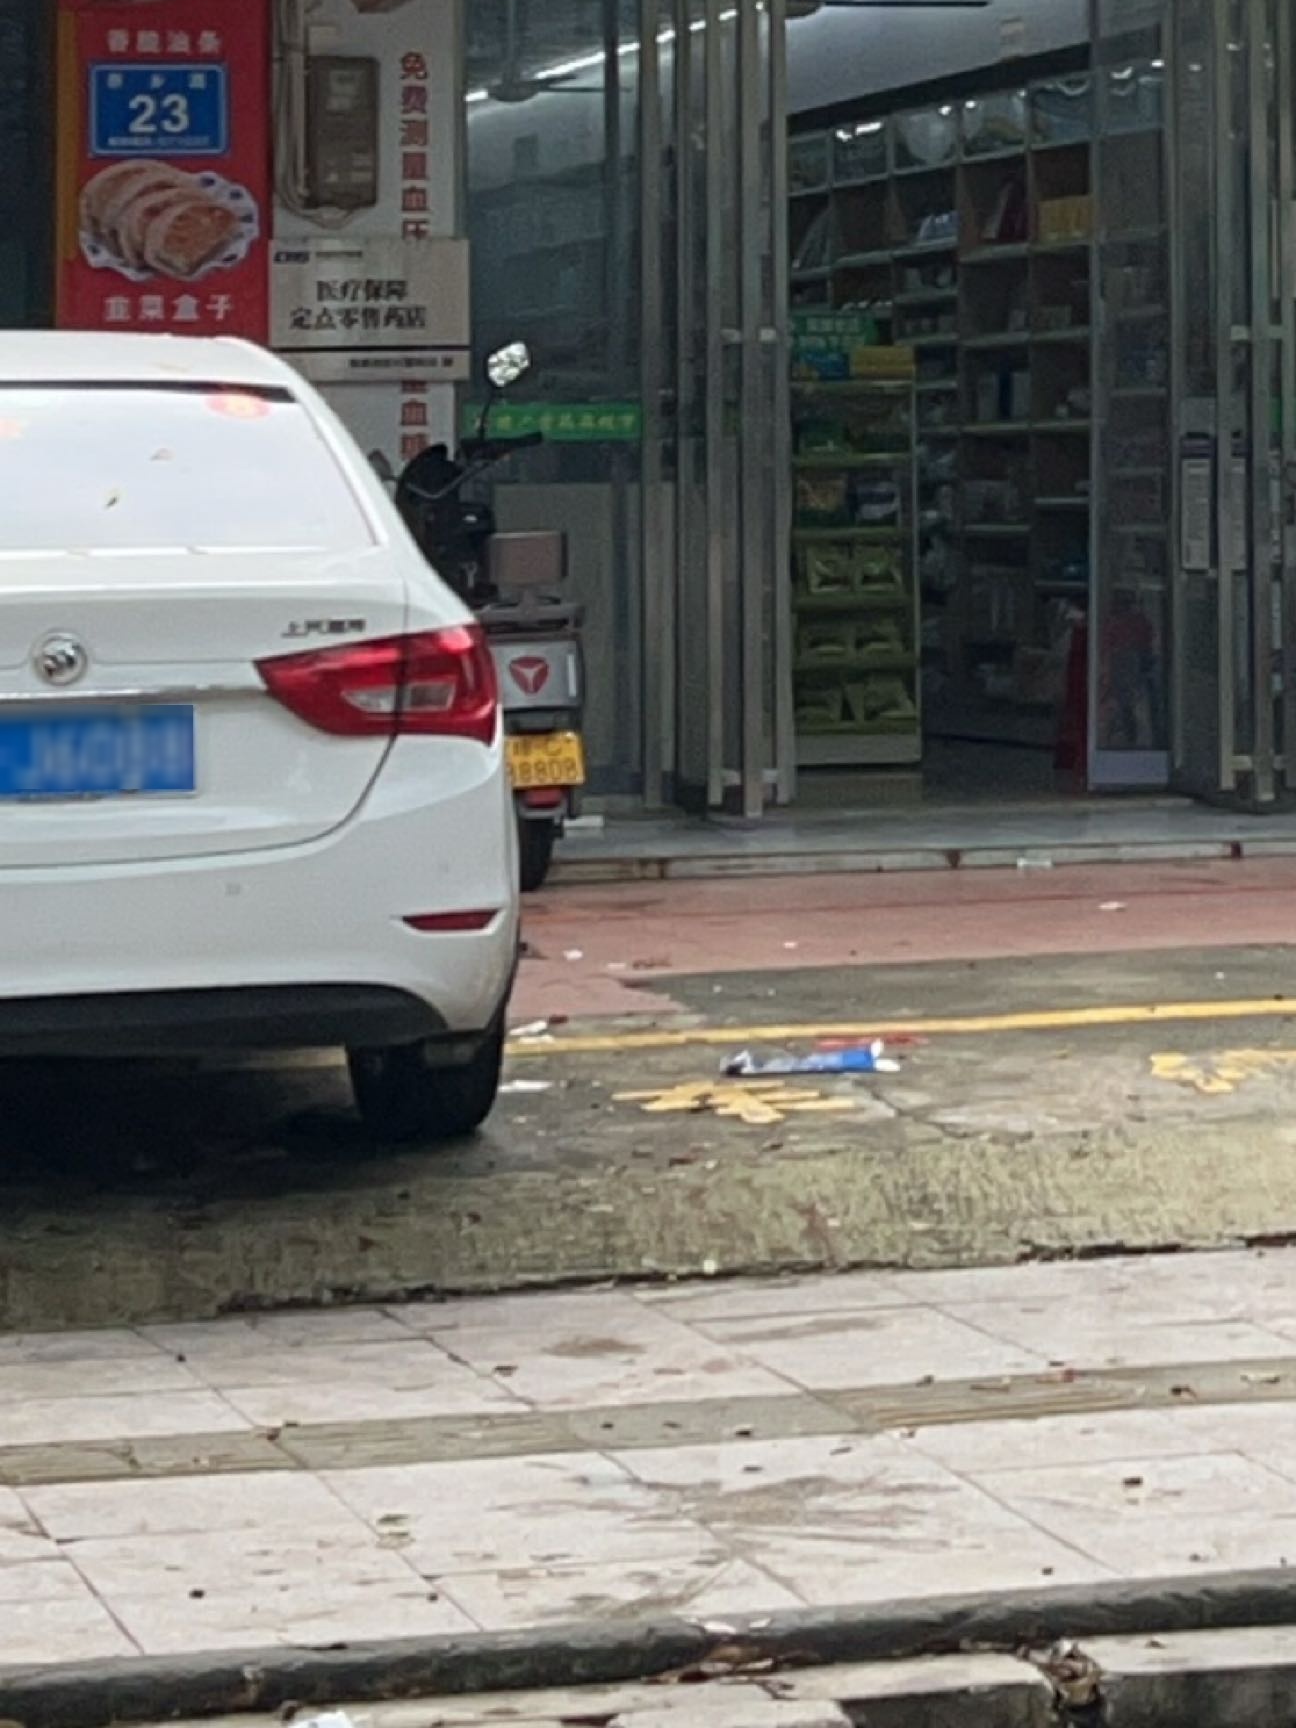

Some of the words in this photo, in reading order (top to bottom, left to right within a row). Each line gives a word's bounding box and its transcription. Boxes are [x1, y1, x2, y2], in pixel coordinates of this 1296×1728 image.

[128, 93, 190, 134] 23
[316, 279, 408, 302] 医疗保障
